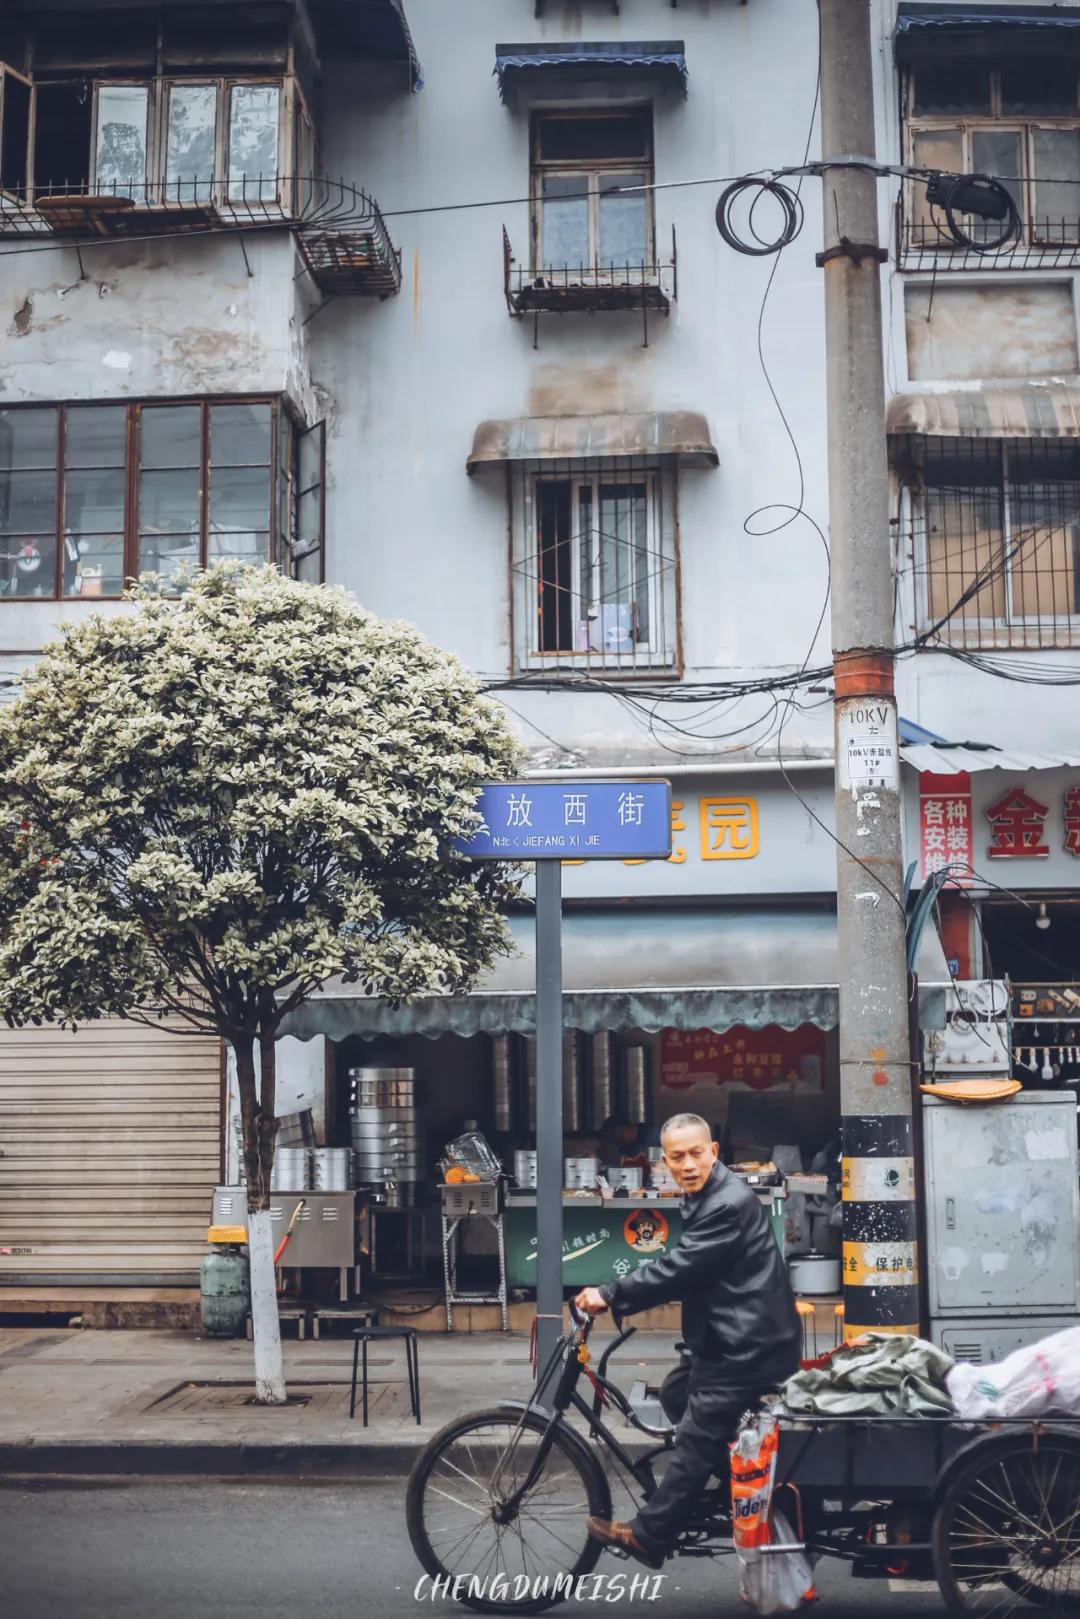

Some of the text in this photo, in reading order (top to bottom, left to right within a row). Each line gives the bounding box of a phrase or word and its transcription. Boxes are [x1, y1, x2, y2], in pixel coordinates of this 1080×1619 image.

[849, 707, 888, 725] 10KV
[924, 799, 968, 825] 各种
[523, 836, 565, 847] JIEFANG
[569, 835, 580, 846] XI
[585, 834, 600, 846] JIE
[924, 826, 969, 851] 安装
